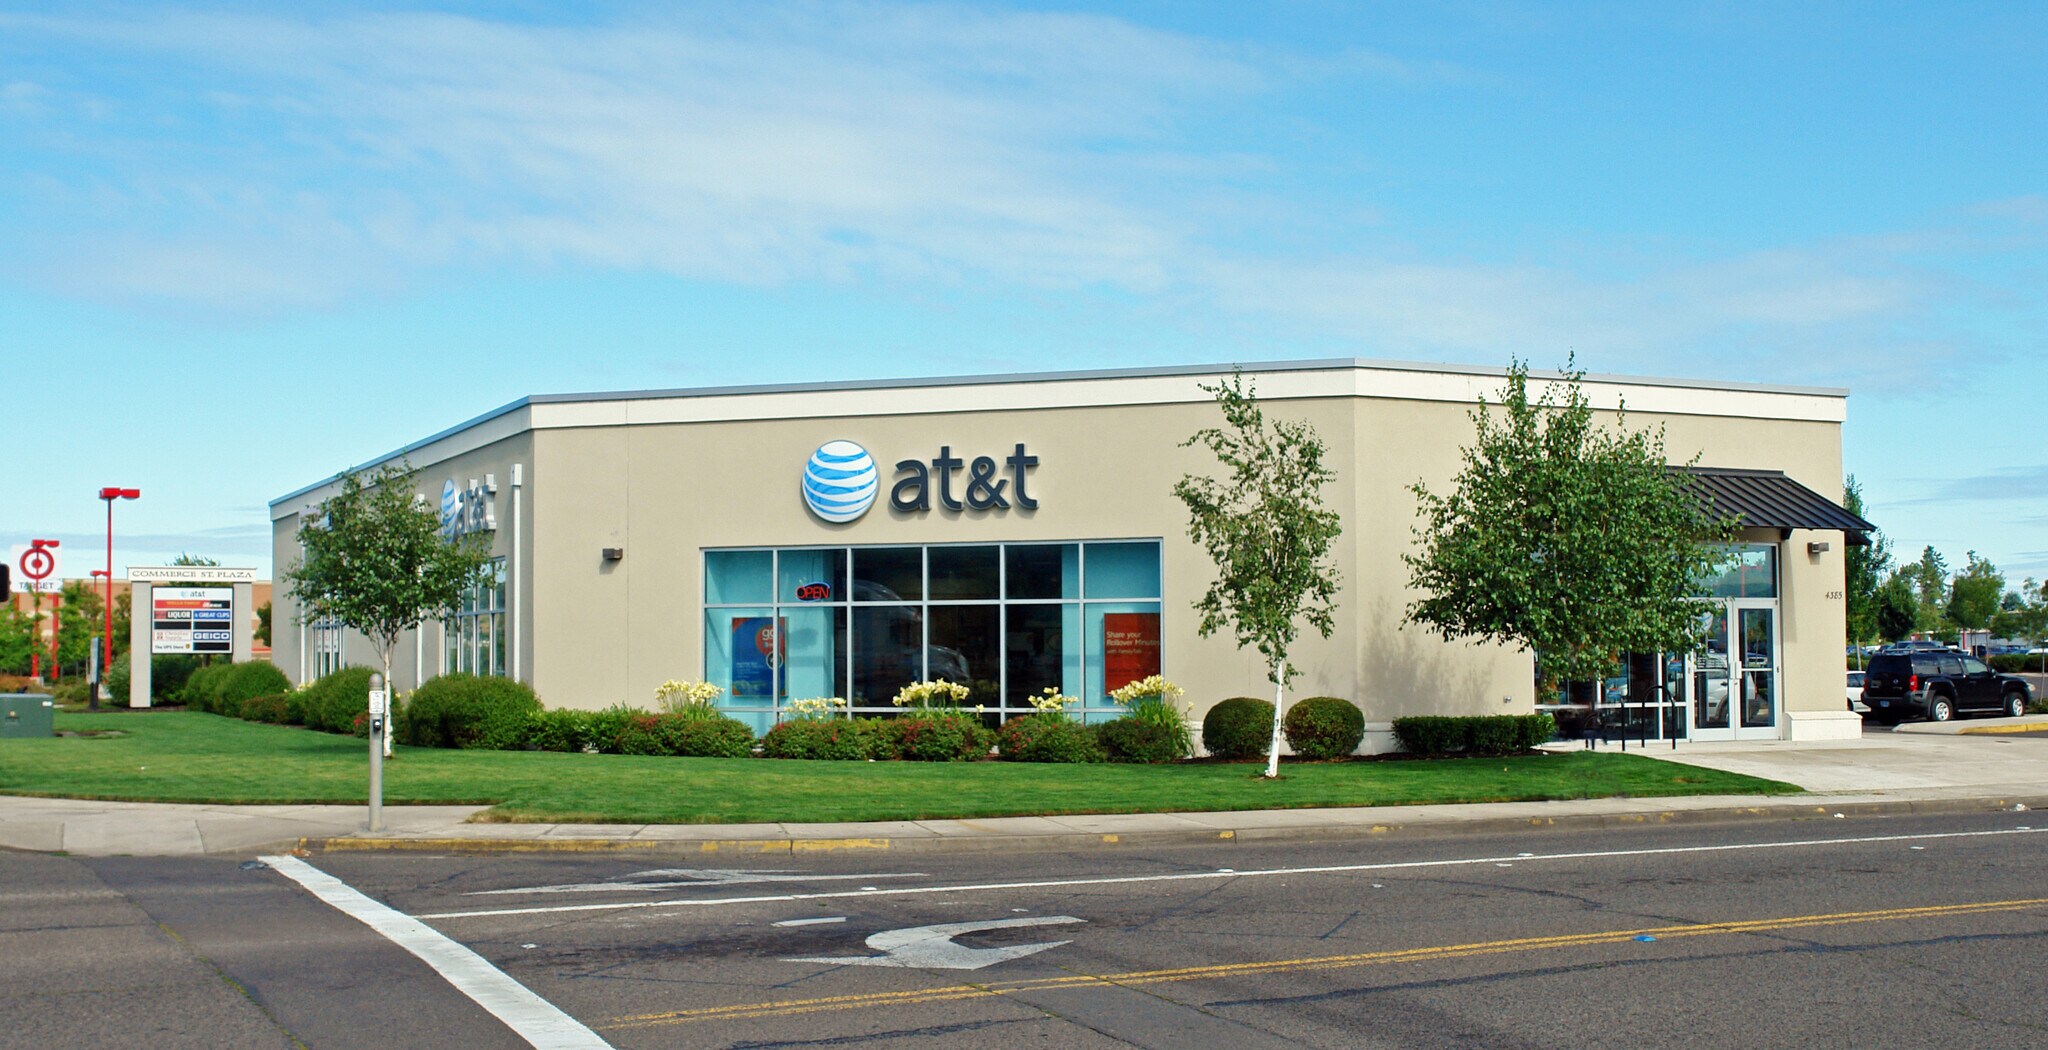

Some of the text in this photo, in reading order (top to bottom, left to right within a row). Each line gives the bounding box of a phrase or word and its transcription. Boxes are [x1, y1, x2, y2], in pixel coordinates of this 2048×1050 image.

[890, 443, 1039, 511] at&t
[796, 586, 829, 599] OPEN
[1825, 591, 1842, 599] 4385
[194, 632, 229, 640] GEICO
